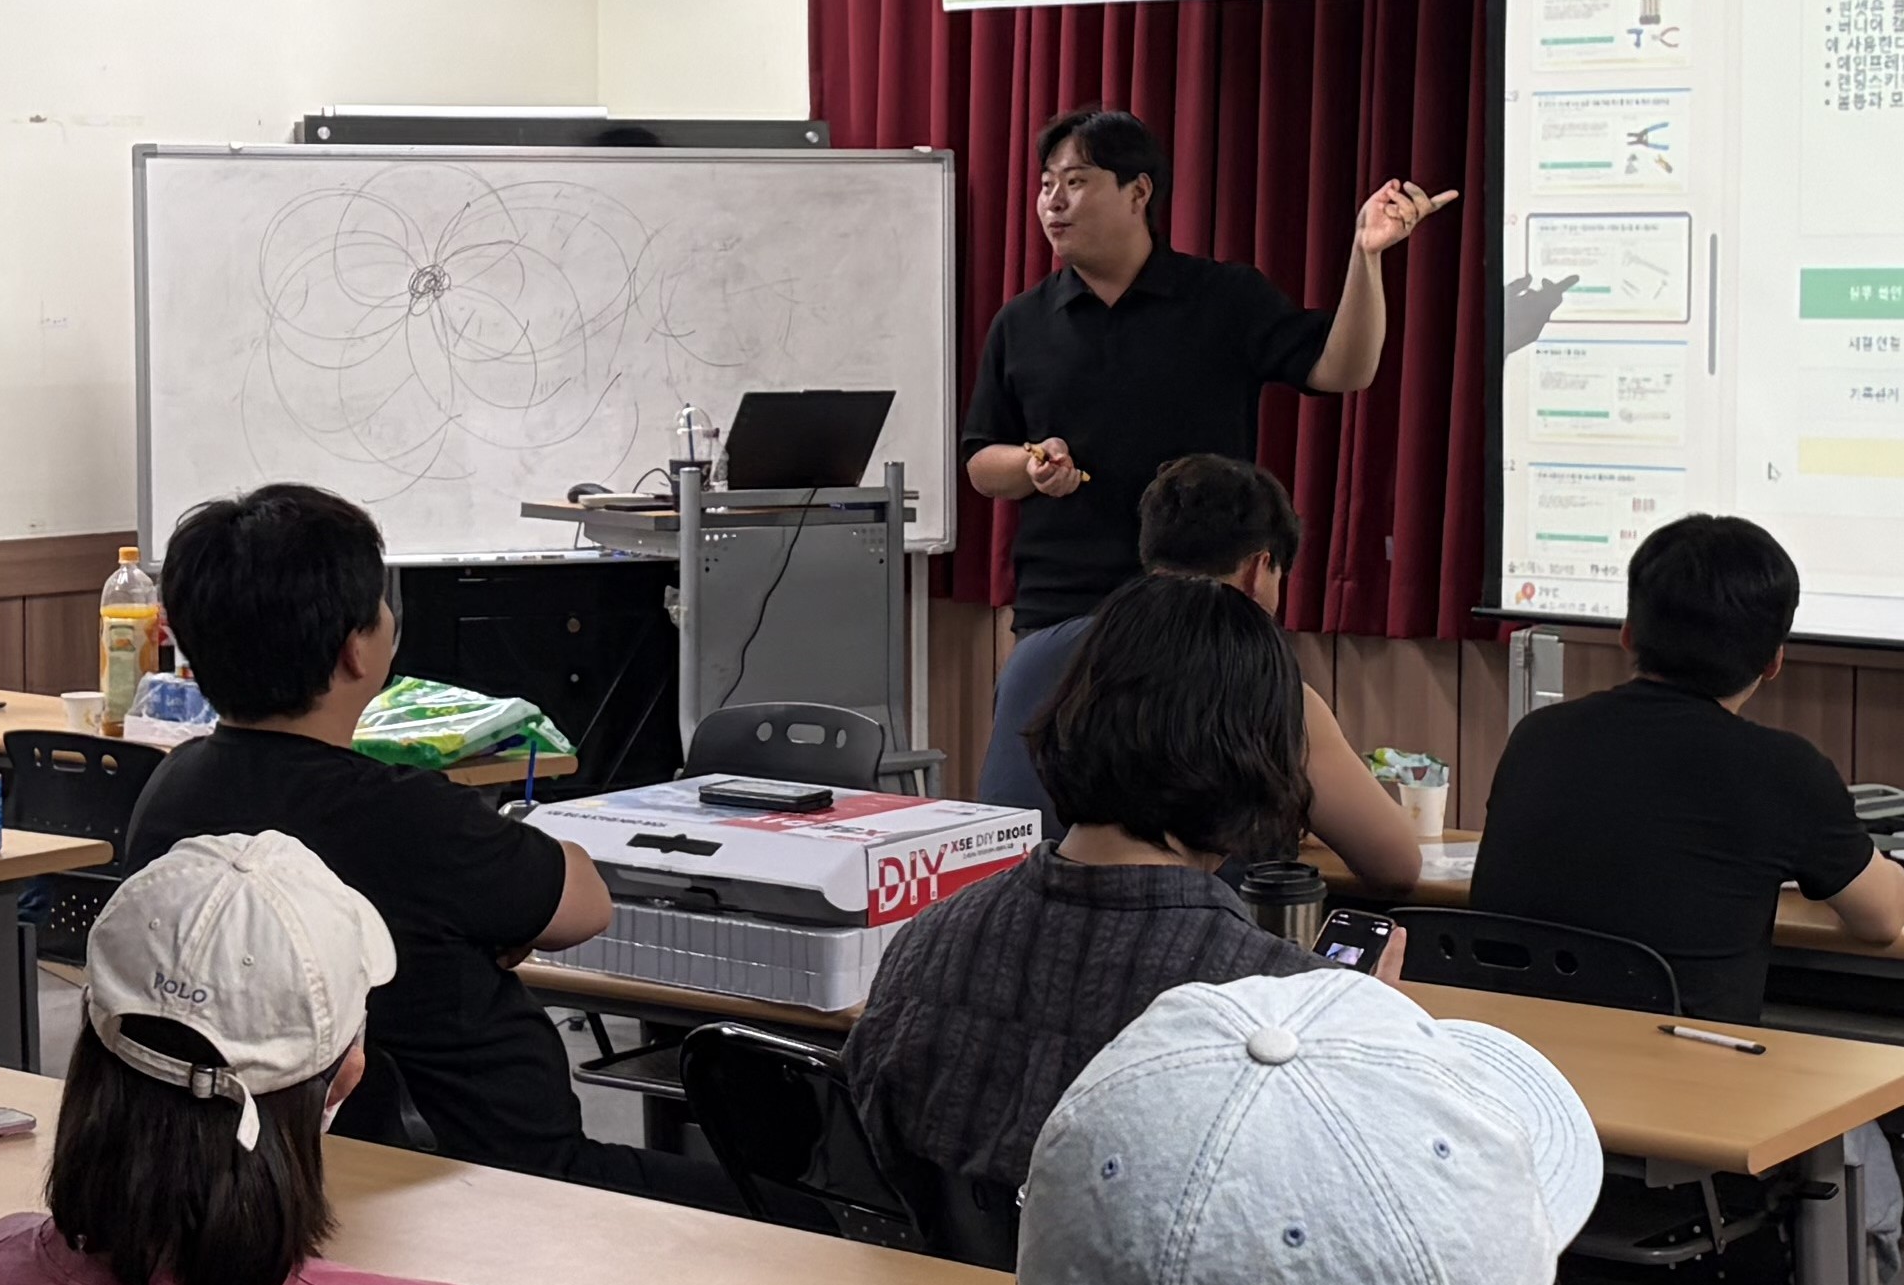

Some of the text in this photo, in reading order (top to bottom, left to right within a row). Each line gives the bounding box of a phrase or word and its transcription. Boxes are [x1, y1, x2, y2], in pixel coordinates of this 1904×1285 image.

[976, 829, 994, 848] DIY
[877, 843, 948, 914] DIY
[154, 972, 208, 1004] POLO
